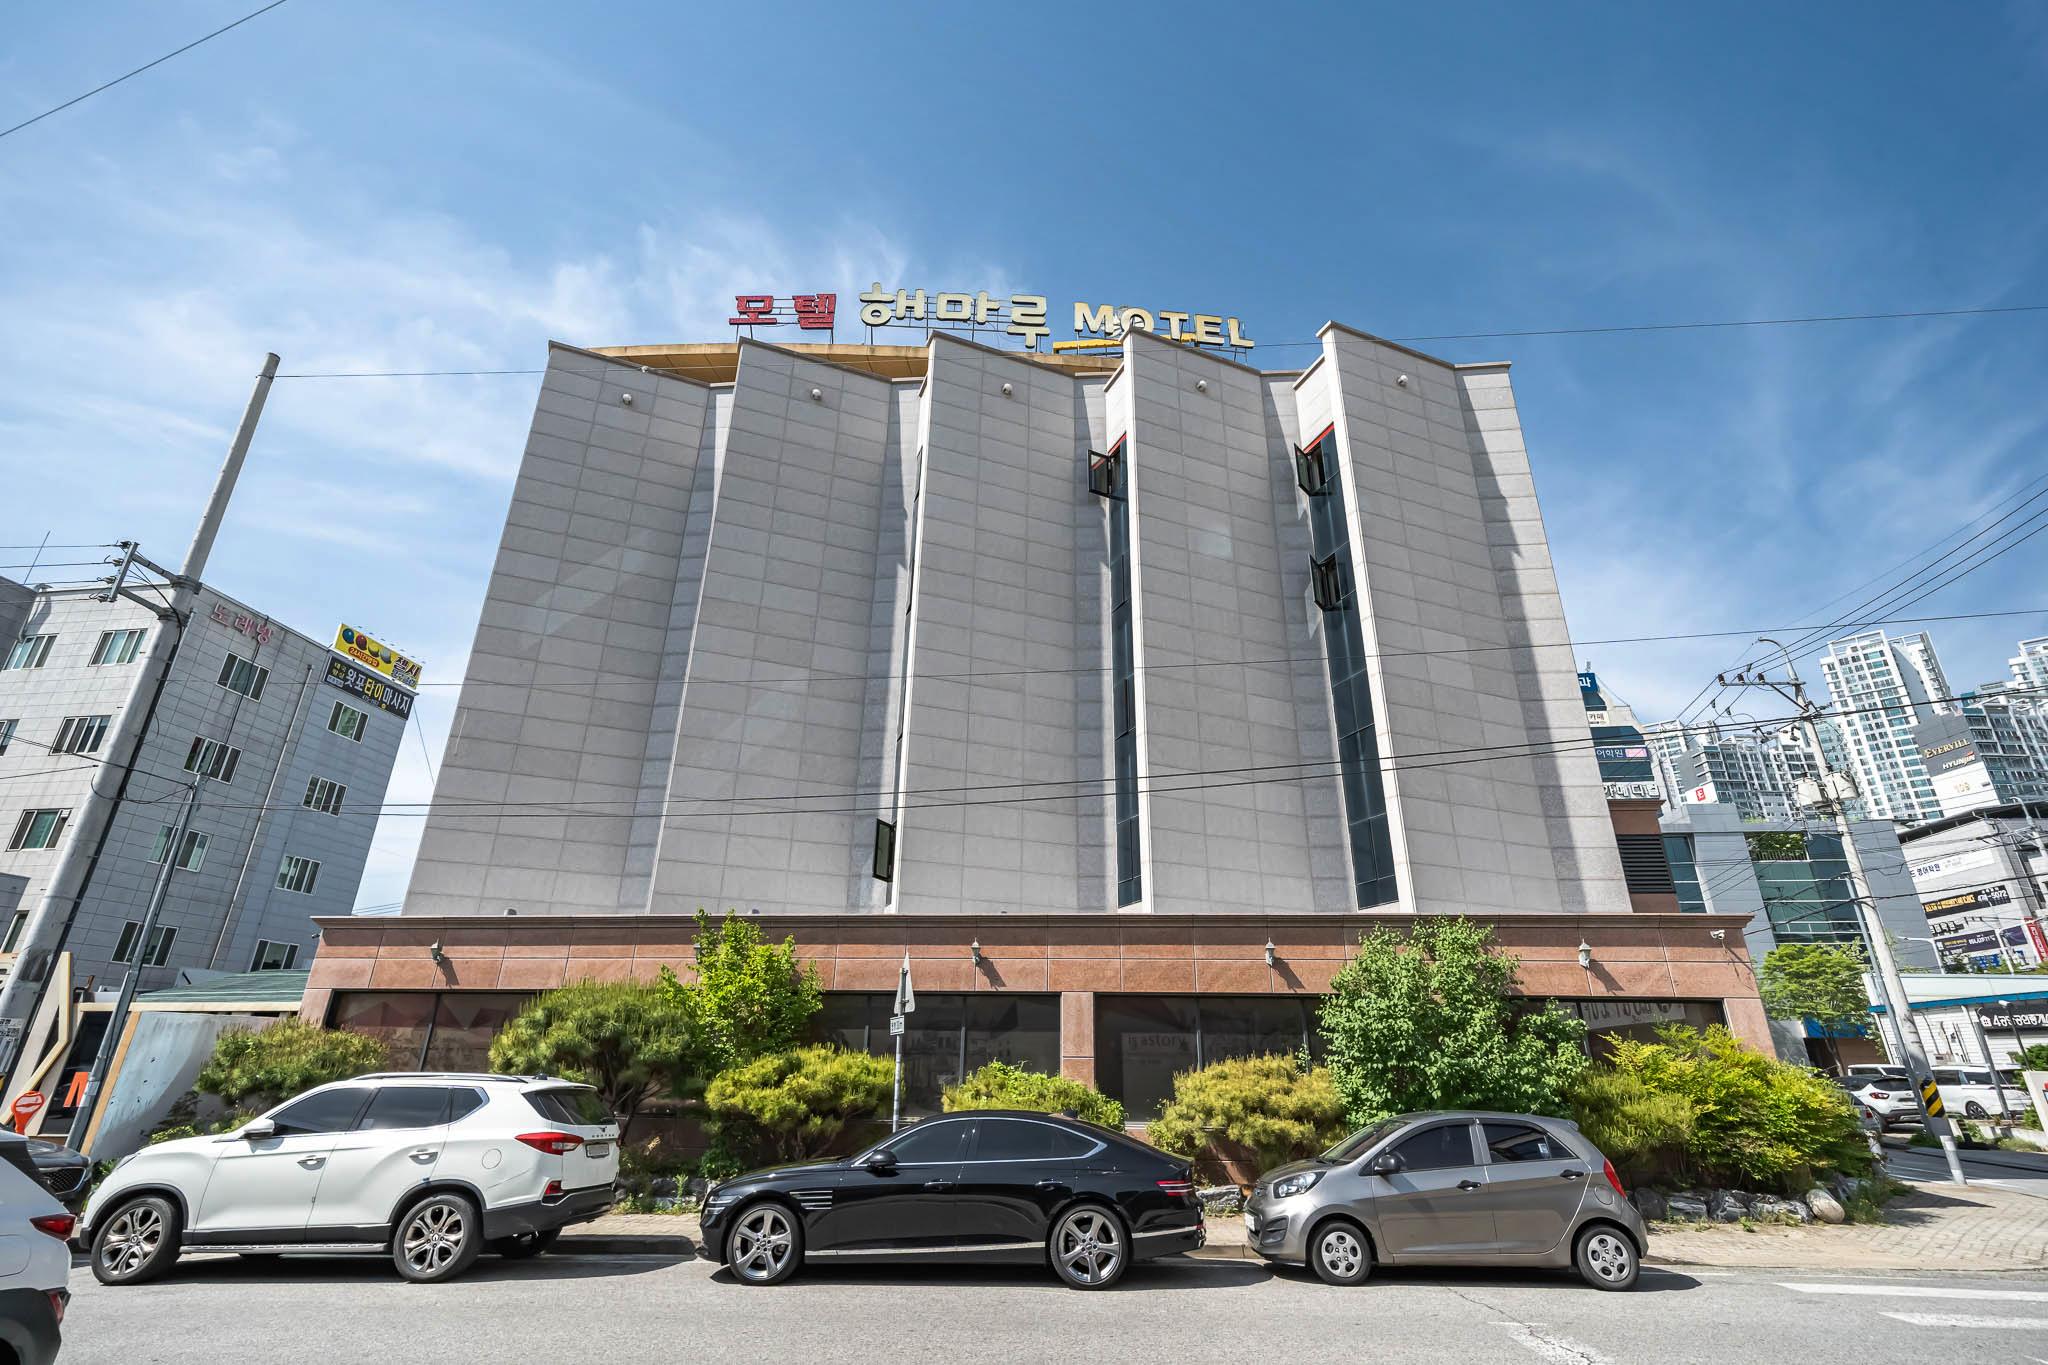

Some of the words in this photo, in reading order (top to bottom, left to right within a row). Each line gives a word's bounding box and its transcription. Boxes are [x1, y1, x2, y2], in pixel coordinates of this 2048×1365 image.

[729, 293, 836, 330] 모텔
[859, 281, 1051, 349] 해마루
[1074, 301, 1255, 349] MOTEL
[210, 601, 273, 645] 노래방
